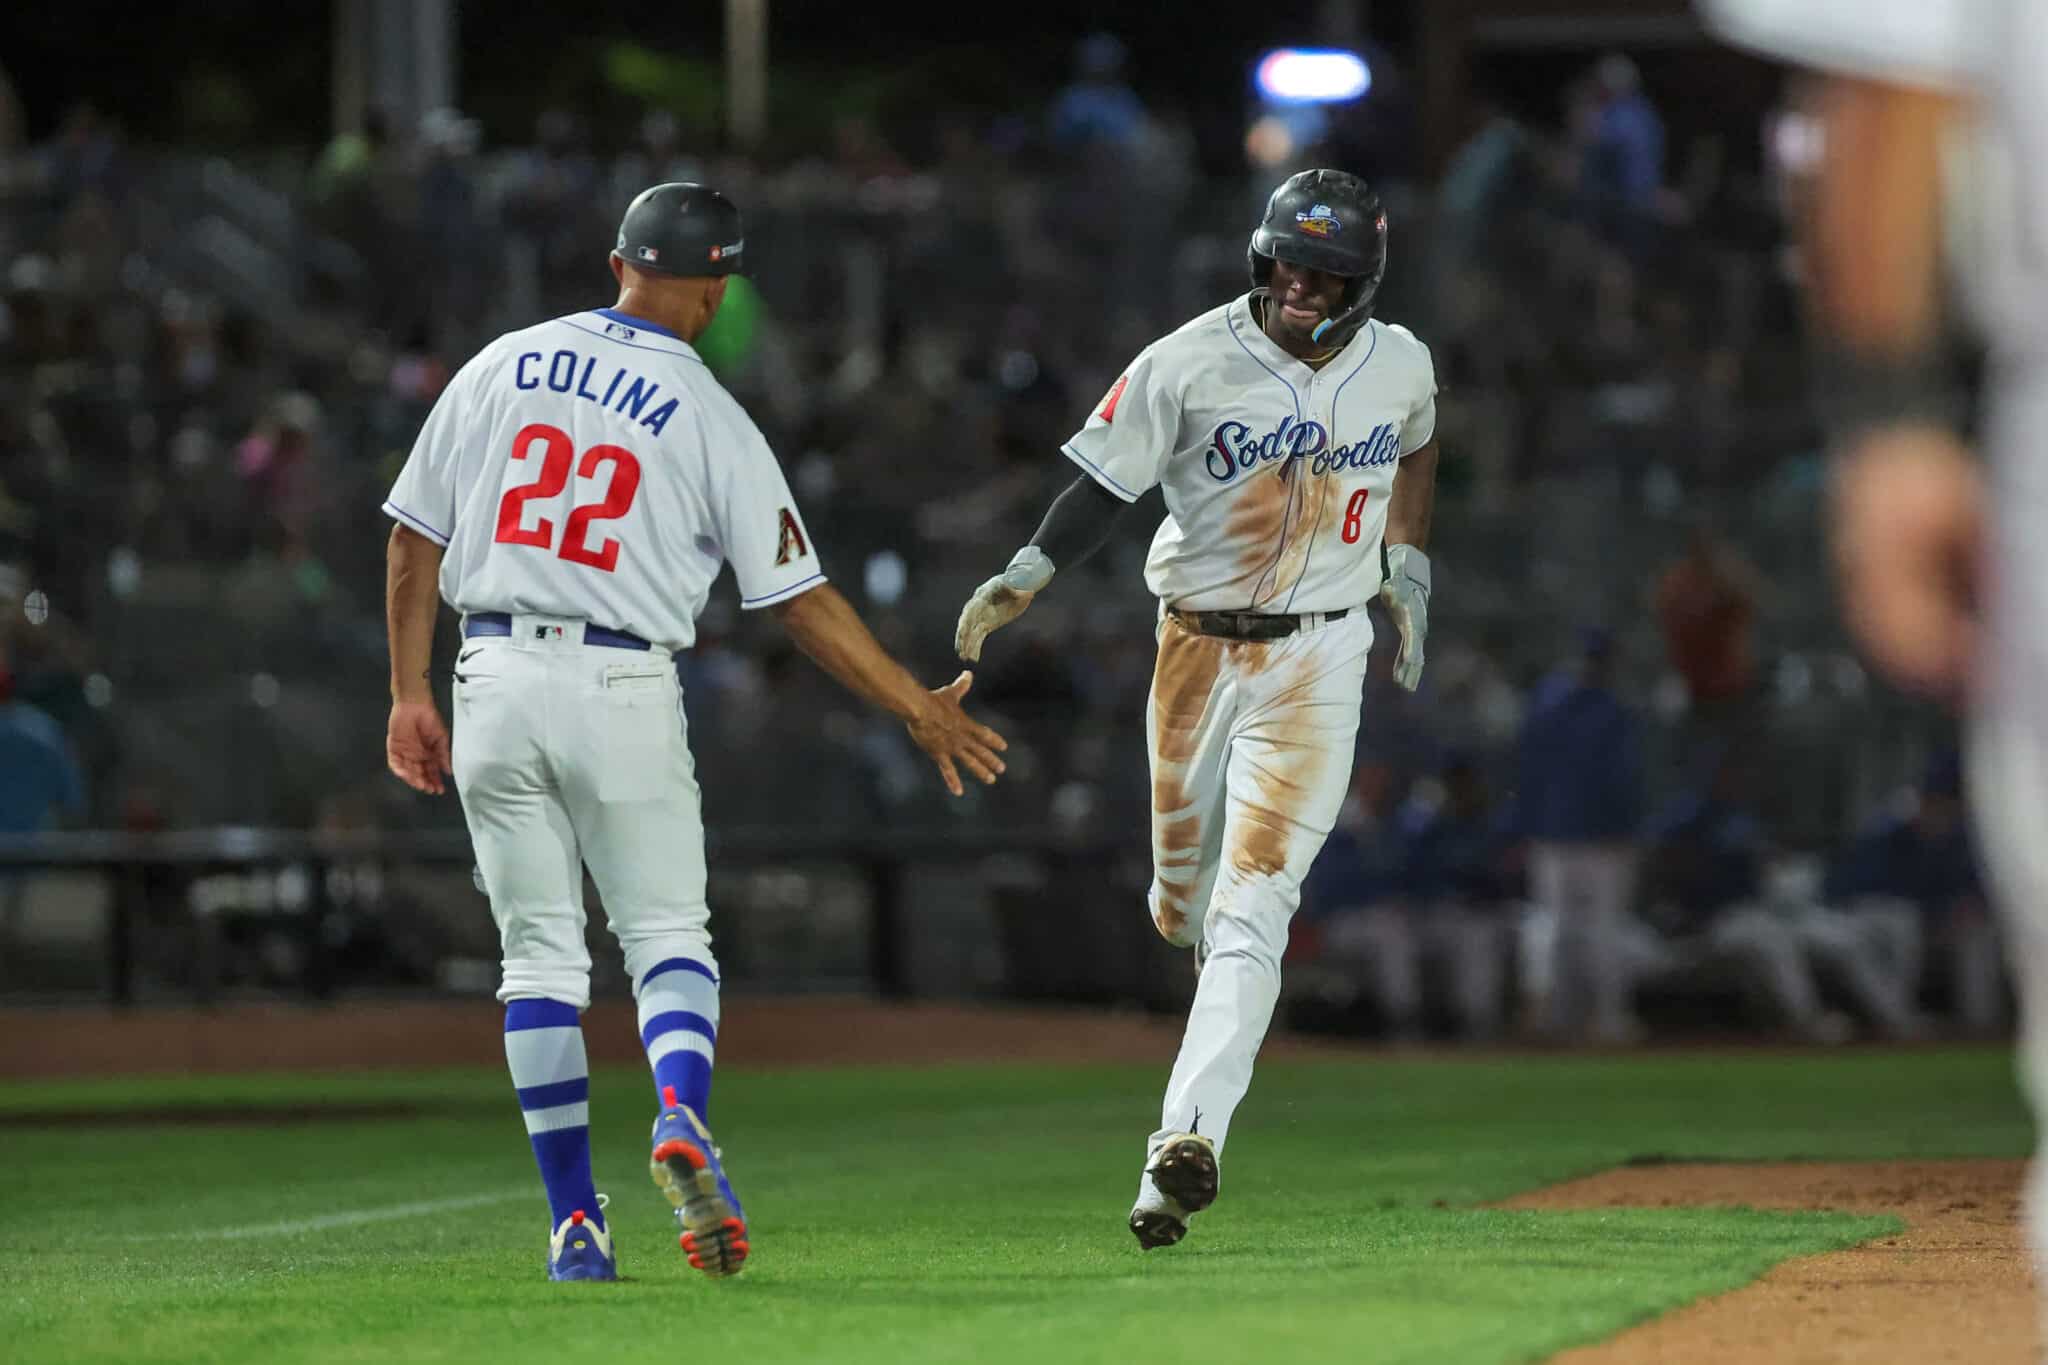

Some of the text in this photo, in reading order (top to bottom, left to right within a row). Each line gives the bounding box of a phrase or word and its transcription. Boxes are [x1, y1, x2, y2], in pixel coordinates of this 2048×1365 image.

[516, 350, 680, 437] COLINA
[494, 423, 641, 572] 22
[1341, 488, 1369, 545] 8
